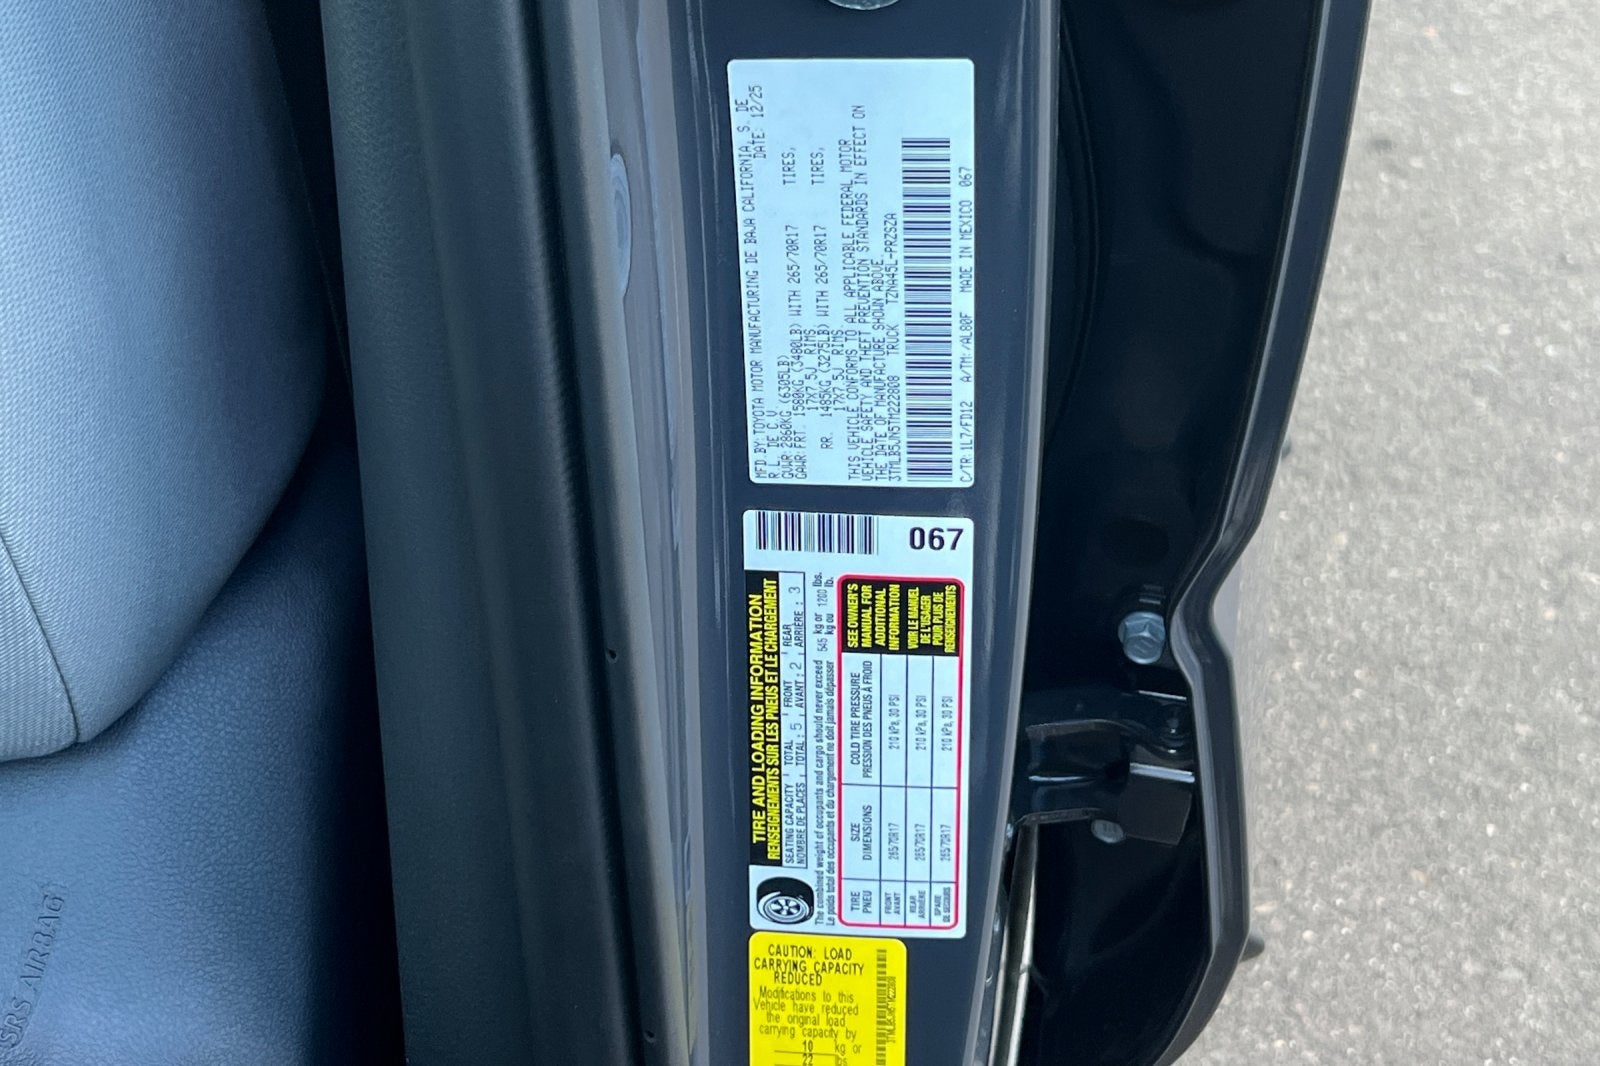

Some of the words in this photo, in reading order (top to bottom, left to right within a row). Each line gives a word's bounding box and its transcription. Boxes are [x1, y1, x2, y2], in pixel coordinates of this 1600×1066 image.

[735, 99, 749, 112] DE
[749, 85, 764, 118] 12/25
[852, 105, 866, 119] ON
[751, 129, 766, 158] DATE:
[839, 139, 853, 172] MOTOR
[853, 126, 867, 166] EFFECT
[738, 140, 754, 212] CALIFORNIA,
[781, 147, 796, 185] TIRES,
[810, 147, 824, 185] TIRES,
[854, 173, 867, 185] IN
[959, 167, 973, 187] 067
[840, 179, 854, 226] FEDERAL
[742, 218, 756, 244] BAJA
[855, 193, 869, 252] STANDARDS
[959, 200, 973, 240] MEXICO
[744, 251, 757, 263] DE
[785, 224, 800, 284] 265/70R17
[813, 224, 828, 284] 265/70R17
[842, 232, 856, 297] APPLICABLE
[884, 213, 899, 304] TZNA45L-PRZSZA
[959, 247, 973, 258] IN
[857, 259, 871, 324] PREVENTION
[959, 266, 973, 292] MADE
[745, 271, 762, 353] MANUFACTURING
[788, 290, 801, 316] WITH
[815, 291, 829, 316] WITH
[844, 305, 857, 324] ALL
[872, 298, 885, 331] SHOWN
[789, 324, 804, 372] (3480LB)
[817, 324, 831, 373] (3275LB)
[845, 329, 857, 342] TO
[859, 330, 872, 361] THEFT
[886, 324, 899, 355] TRUCK
[750, 360, 763, 391] MOTOR
[777, 355, 791, 403] (6305LB)
[845, 349, 859, 400] CONFORMS
[860, 368, 872, 387] AND
[873, 337, 886, 406] MANUFACTURE
[792, 379, 805, 416] 1580KG
[805, 367, 819, 411] 17X7.5J
[819, 380, 832, 417] 1485KG
[833, 367, 846, 411] 17X7.5J
[752, 397, 766, 435] TOYOTA
[860, 394, 874, 431] SAFETY
[874, 413, 887, 425] OF
[779, 410, 793, 448] 2860KG
[847, 406, 860, 449] VEHICLE
[767, 435, 779, 447] DE
[875, 432, 887, 456] DATE
[848, 455, 861, 480] THIS
[862, 438, 875, 480] VEHICLE
[876, 462, 888, 480] THE
[909, 526, 963, 551] 067
[813, 572, 822, 587] lbs.
[848, 584, 858, 628] OWNER'S
[862, 585, 872, 604] FOR
[908, 587, 919, 618] MANUEL
[933, 592, 943, 602] DE
[763, 578, 778, 652] CHARGEMENT
[814, 613, 823, 621] or
[861, 606, 872, 647] MANUAL
[875, 588, 886, 646] ADDITIONAL
[889, 584, 900, 650] INFORMATION
[908, 620, 918, 629] LE
[920, 595, 931, 632] L'USAGER
[933, 604, 943, 623] PLUS
[945, 585, 956, 652] RENSEIGNEMENTS
[783, 624, 792, 647] REAR
[792, 611, 804, 647] ARRIÈRE
[813, 624, 824, 634] kg
[848, 629, 858, 648] SEE
[908, 631, 918, 649] VOIR
[920, 633, 931, 643] DE
[933, 625, 943, 645] POUR
[748, 594, 764, 700] INFORMATION
[765, 654, 778, 667] LE
[789, 662, 802, 670] 2
[863, 661, 872, 685] FROID
[765, 670, 778, 683] ET
[813, 660, 823, 688] exceed
[765, 686, 778, 720] PNEUS
[783, 680, 792, 707] FRONT
[795, 680, 804, 708] AVANT
[813, 691, 823, 713] never
[851, 672, 860, 718] PRESSURE
[825, 698, 836, 724] jamais
[863, 694, 872, 720] PNEUS
[750, 704, 765, 771] LOADING
[765, 722, 779, 742] LES
[814, 716, 823, 743] should
[825, 726, 834, 740] doit
[851, 720, 860, 740] TIRE
[863, 722, 872, 737] DES
[766, 744, 779, 765] SUR
[784, 740, 793, 766] TOTAL
[795, 741, 805, 766] TOTAL
[814, 745, 825, 768] cargo
[825, 742, 835, 751] ne
[851, 742, 860, 765] COLD
[863, 740, 872, 778] PRESSION
[814, 771, 823, 785] and
[825, 754, 836, 798] chargement
[752, 775, 766, 807] AND
[796, 782, 805, 813] PLACES
[766, 768, 780, 859] RENSEIGNEMENTS
[785, 784, 794, 826] CAPACITY
[814, 788, 825, 828] occupants
[825, 800, 835, 809] du
[752, 810, 766, 843] TIRE
[796, 816, 805, 826] DE
[851, 823, 860, 842] SIZE
[863, 805, 872, 860] DIMENSIONS
[785, 828, 794, 864] SEATING
[796, 829, 805, 864] NOMBRE
[826, 820, 836, 859] occupants
[814, 841, 825, 868] weight
[826, 861, 835, 874] des
[815, 870, 824, 908] combined
[826, 876, 835, 893] total
[826, 895, 837, 915] poids
[851, 891, 860, 911] TIRE
[863, 890, 872, 914] PNEU
[815, 911, 824, 925] The
[826, 917, 835, 926] Le
[768, 944, 816, 959] CAUTION:
[824, 947, 852, 960] LOAD
[0, 997, 32, 1048] SRS
[20, 894, 65, 992] AIRBAG
[754, 957, 806, 973] CARRYING
[814, 962, 864, 975] CAPACITY
[774, 971, 822, 986] REDUCED
[753, 998, 785, 1011] Vehicle
[793, 1002, 814, 1012] have
[822, 1004, 858, 1015] reduced
[759, 986, 816, 1001] Modifications
[838, 991, 853, 1003] this
[766, 1011, 780, 1023] the
[787, 1014, 819, 1027] original
[826, 1015, 845, 1027] load
[759, 1024, 795, 1039] carrying
[802, 1027, 838, 1041] capacity
[845, 1028, 856, 1041] by
[802, 1040, 813, 1052] 10
[853, 1044, 861, 1054] or
